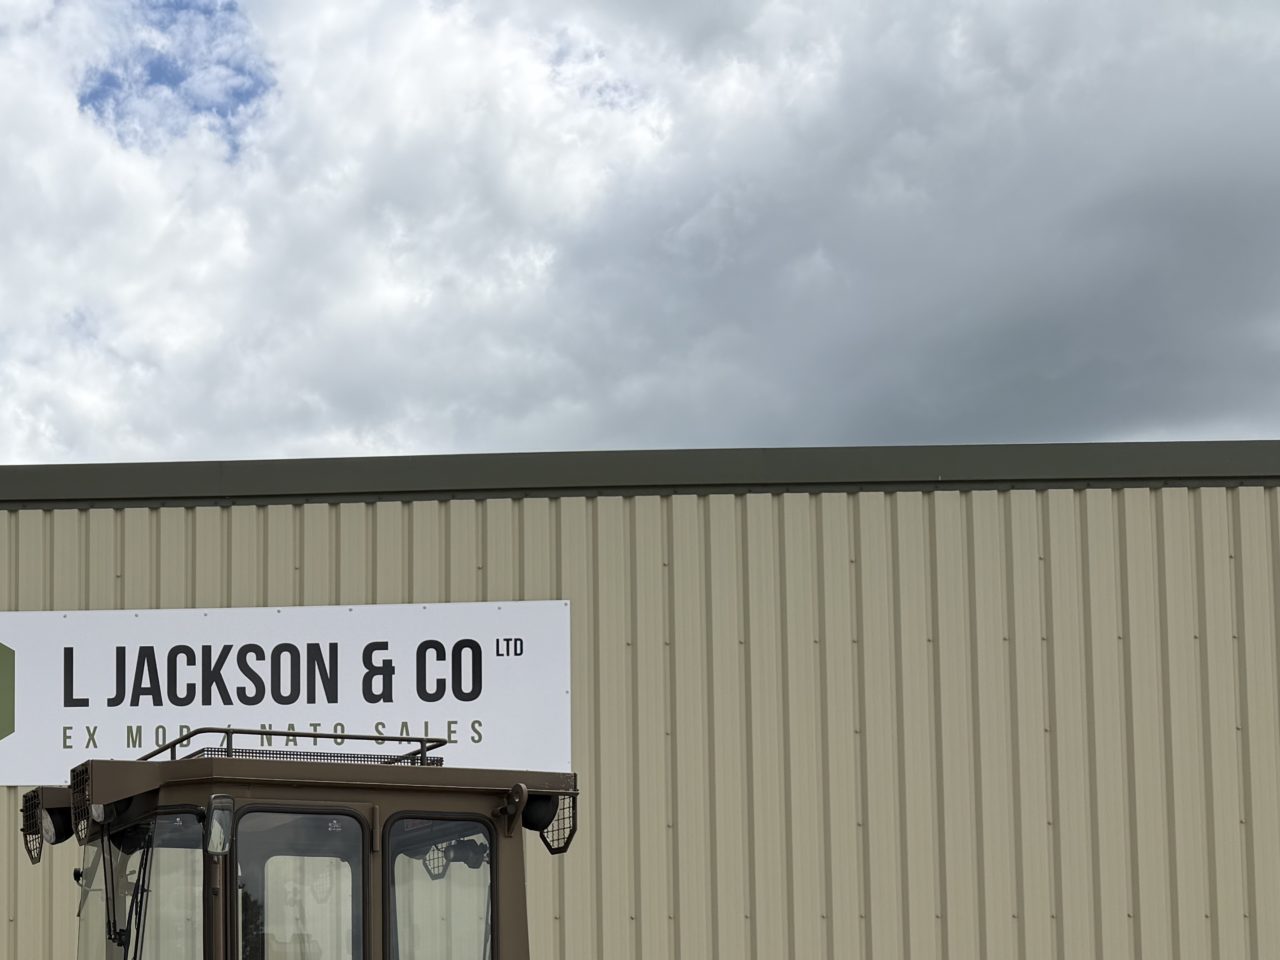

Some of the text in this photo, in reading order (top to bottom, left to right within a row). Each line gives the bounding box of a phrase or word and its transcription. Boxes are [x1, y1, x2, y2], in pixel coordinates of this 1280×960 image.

[64, 638, 523, 707] L JACKSON & CO LTD
[62, 725, 98, 749] EX
[126, 724, 191, 749] MOD
[260, 722, 346, 747] NATO
[374, 720, 483, 745] SALES
